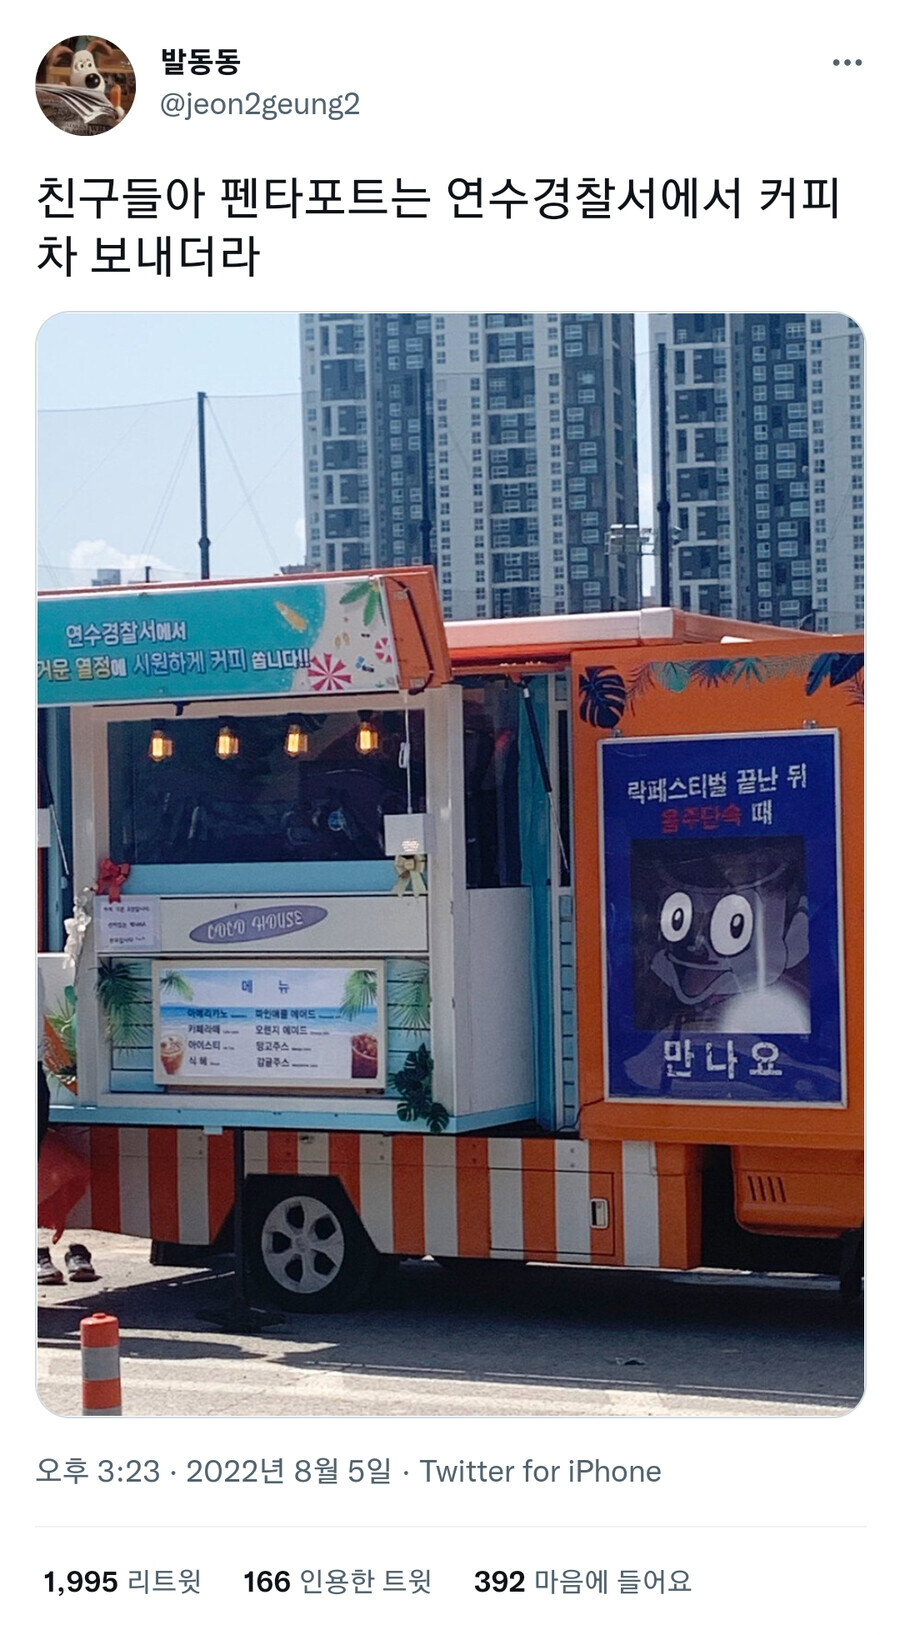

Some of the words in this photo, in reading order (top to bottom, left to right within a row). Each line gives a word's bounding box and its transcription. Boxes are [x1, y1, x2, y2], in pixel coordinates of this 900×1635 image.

[65, 619, 187, 648] 연수경찰서에서
[75, 656, 127, 680] 열정에
[134, 650, 205, 677] 시원하게
[210, 648, 247, 673] 커피
[627, 771, 728, 805] 락페스티벌
[736, 765, 779, 796] 끝난
[786, 762, 808, 790] 뒤
[661, 803, 742, 834] 음주단속
[750, 799, 773, 825] 때
[207, 919, 246, 940] COCO
[252, 909, 304, 932] HOUSE
[188, 1040, 220, 1050] 아이스티
[255, 1025, 280, 1036] 오렌지
